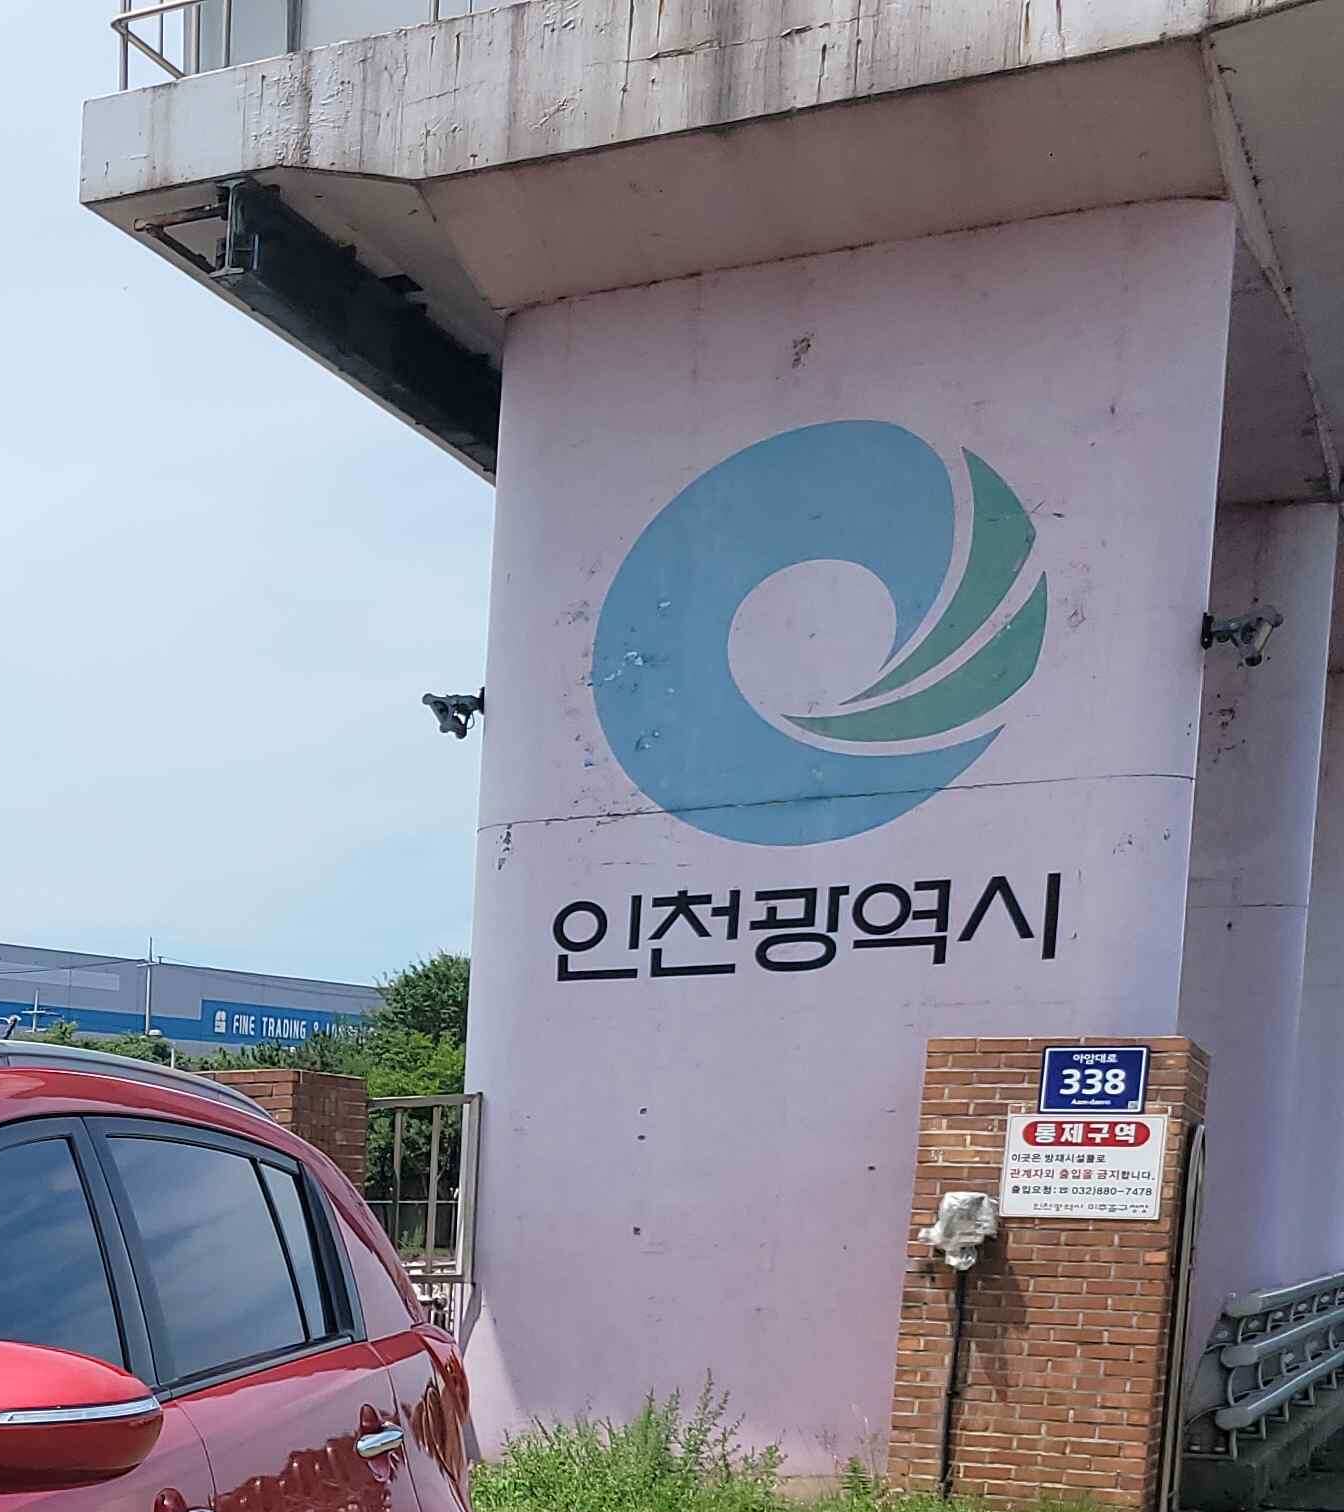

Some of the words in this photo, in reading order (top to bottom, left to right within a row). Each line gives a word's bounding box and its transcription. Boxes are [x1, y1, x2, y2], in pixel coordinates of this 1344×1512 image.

[552, 872, 1062, 982] 인천광역시
[232, 1014, 255, 1035] FINE
[262, 1016, 306, 1040] TRADING
[1059, 1068, 1126, 1095] 338
[1035, 1123, 1136, 1144] 통제구역
[1011, 1153, 1041, 1163] 이곳은
[1010, 1168, 1055, 1179] 관계자외
[1059, 1168, 1093, 1180] 출입을
[1072, 1186, 1153, 1197] 032)880-7478
